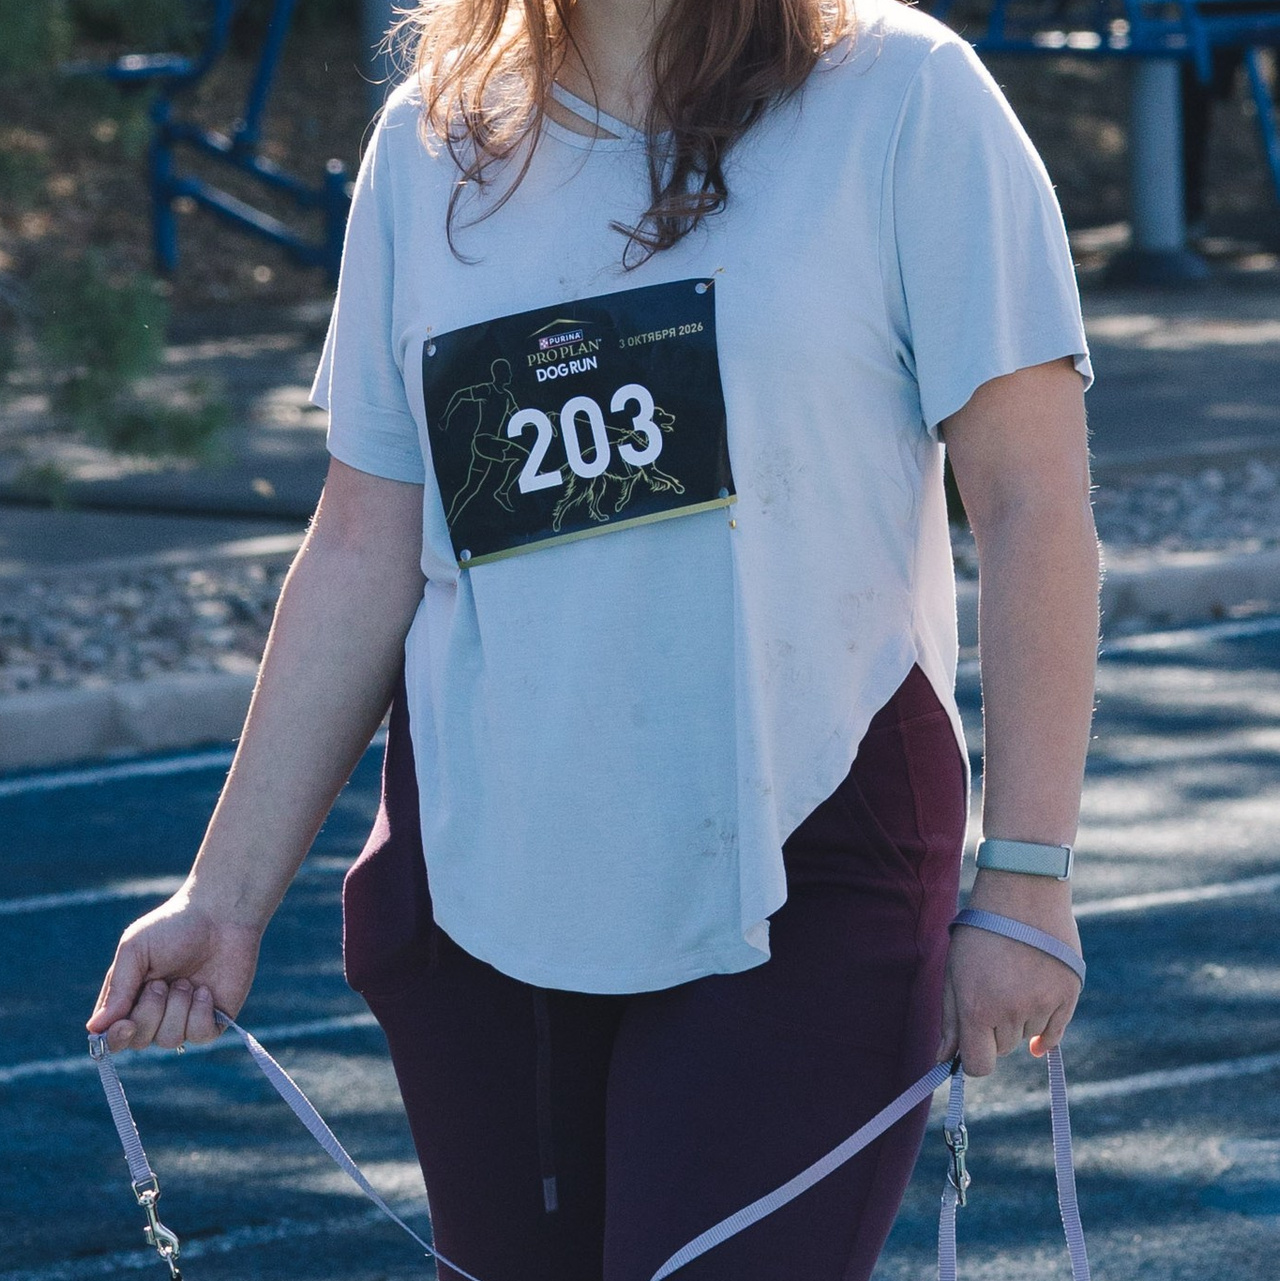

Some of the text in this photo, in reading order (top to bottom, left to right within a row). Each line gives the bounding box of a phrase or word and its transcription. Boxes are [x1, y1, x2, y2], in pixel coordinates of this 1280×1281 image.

[549, 332, 581, 345] PURINA
[627, 327, 676, 347] ОКТЯБРЯ
[678, 322, 704, 336] 2026
[527, 339, 600, 367] PRO PLAN
[536, 356, 598, 382] DOG RUN
[507, 383, 663, 494] 203
